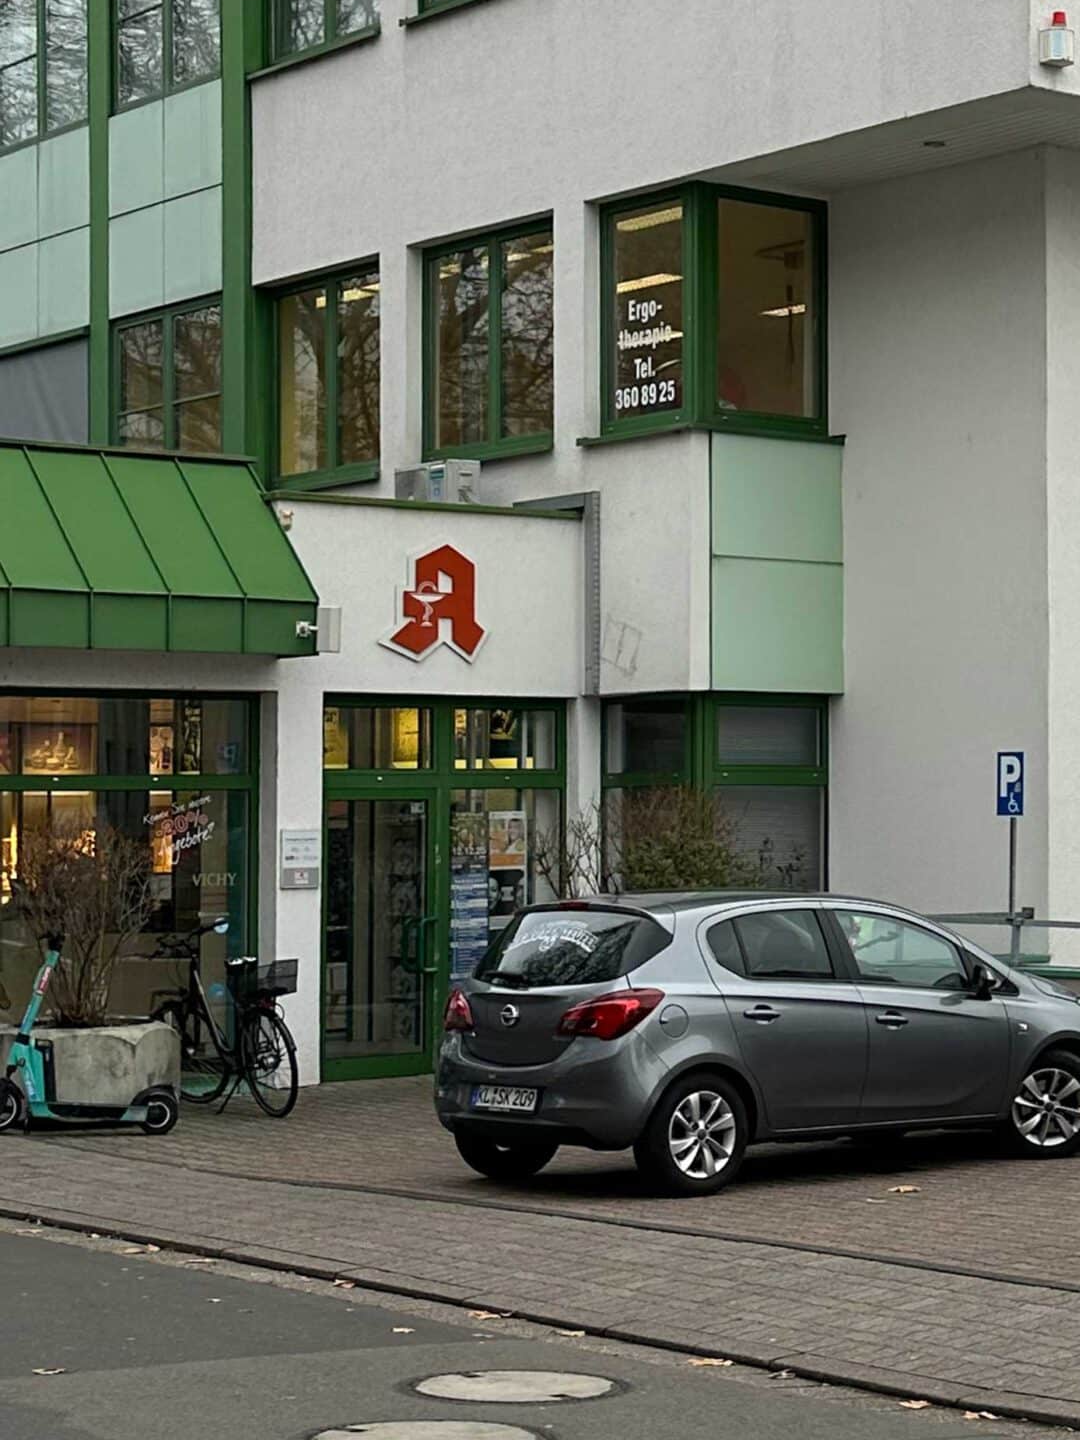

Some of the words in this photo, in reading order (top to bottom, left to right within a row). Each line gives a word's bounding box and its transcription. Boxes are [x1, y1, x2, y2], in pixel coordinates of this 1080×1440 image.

[628, 300, 662, 323] Ergo-
[619, 321, 672, 350] therapie
[634, 356, 656, 379] Tel.
[615, 386, 639, 410] 360
[641, 383, 657, 406] 89
[659, 380, 675, 403] 25
[1000, 756, 1021, 797] P
[192, 872, 237, 887] VICHY
